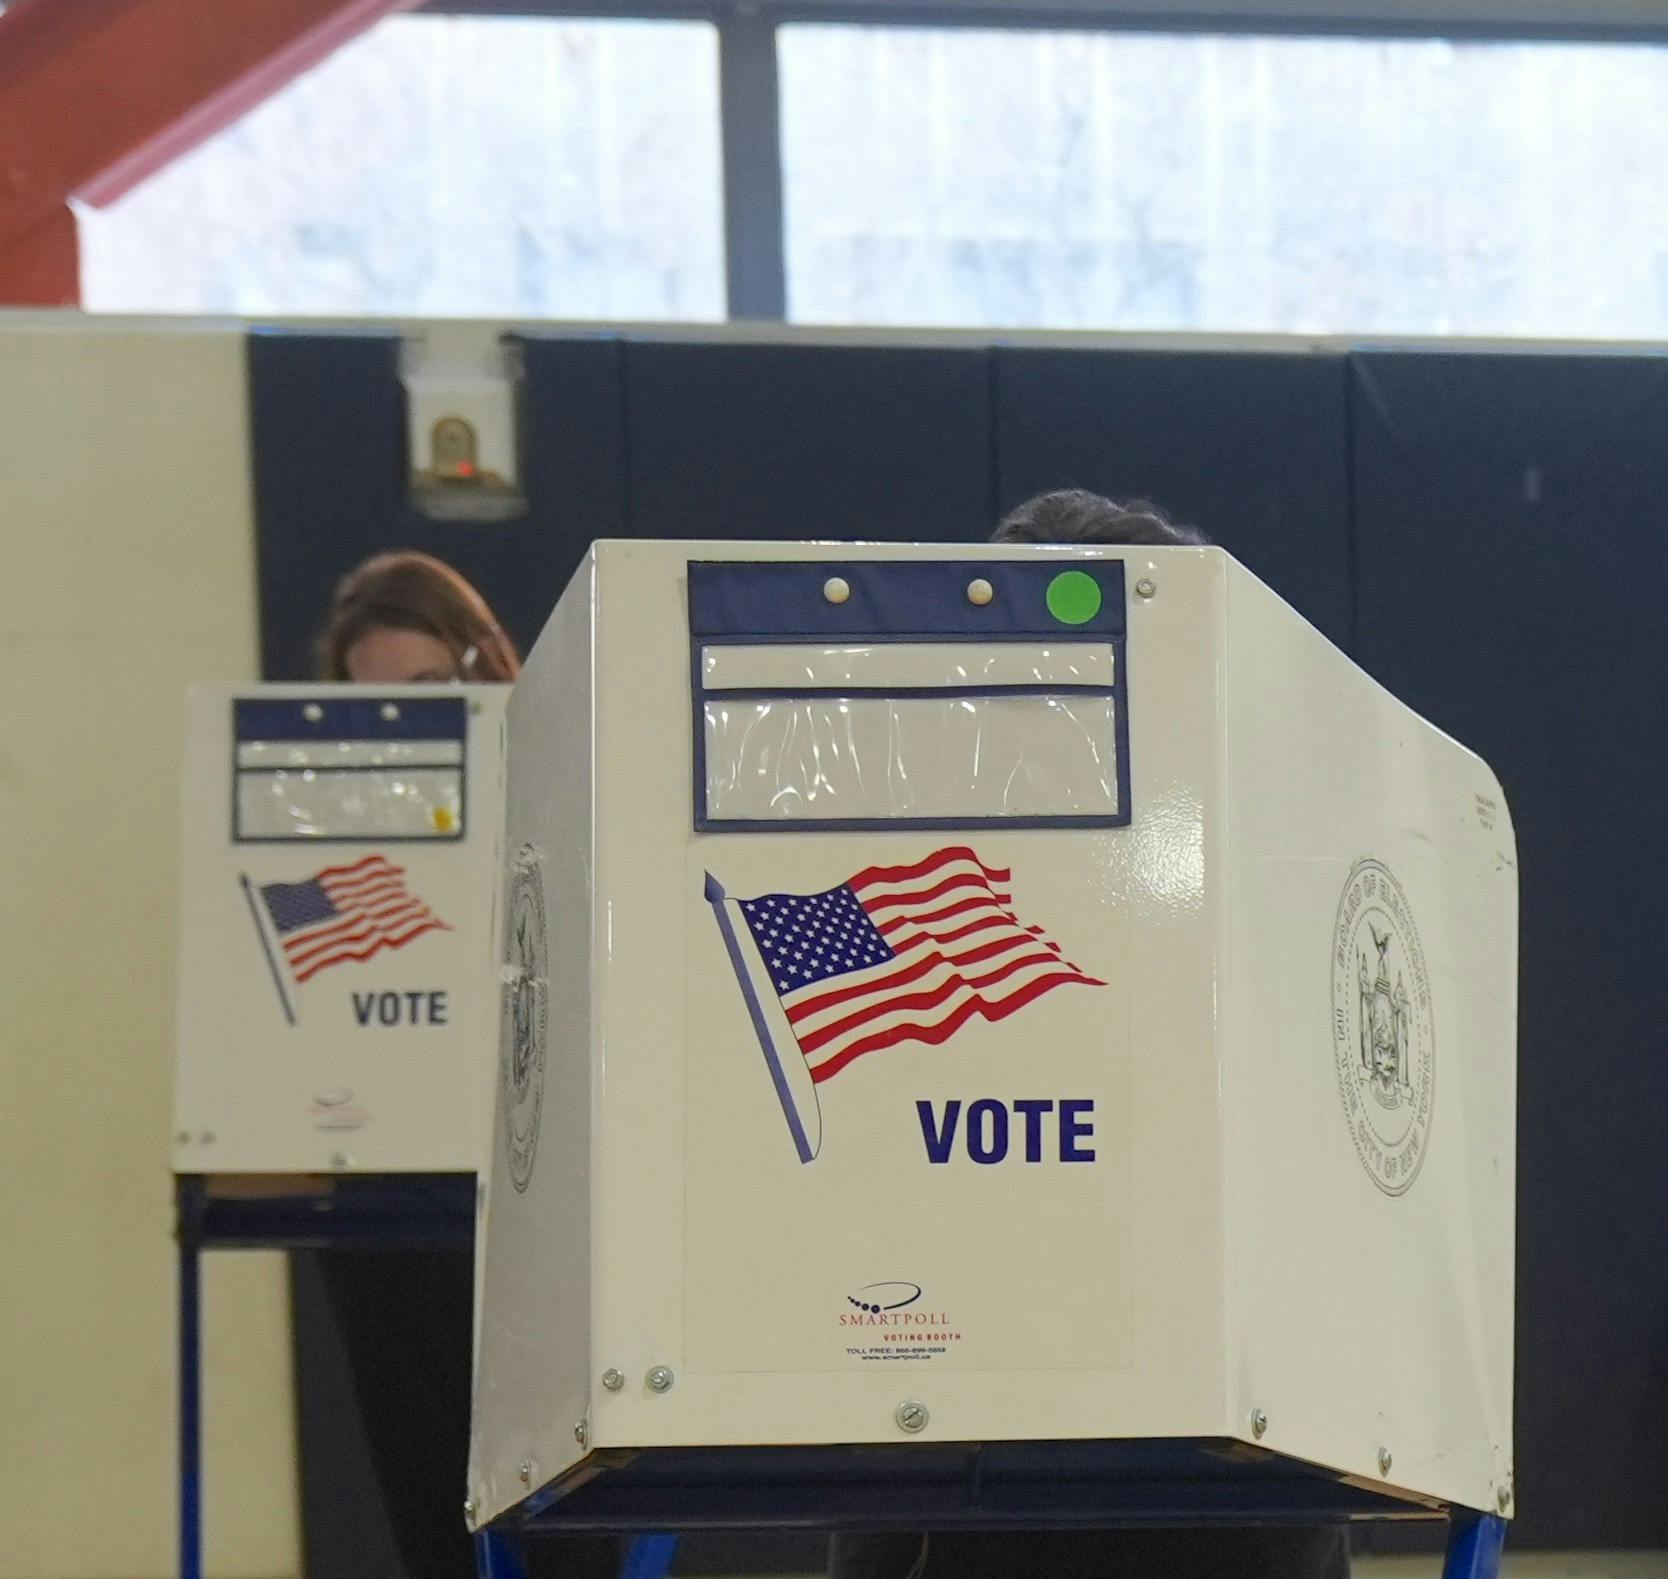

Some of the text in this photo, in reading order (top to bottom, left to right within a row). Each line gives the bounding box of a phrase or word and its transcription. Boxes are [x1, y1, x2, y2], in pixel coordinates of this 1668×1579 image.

[351, 990, 448, 1026] VOTE
[915, 1098, 1096, 1165] VOTE
[839, 1312, 950, 1326] SMARTPOLL
[883, 1332, 961, 1342] VOTING BOOTH
[846, 1347, 867, 1355] TOLL
